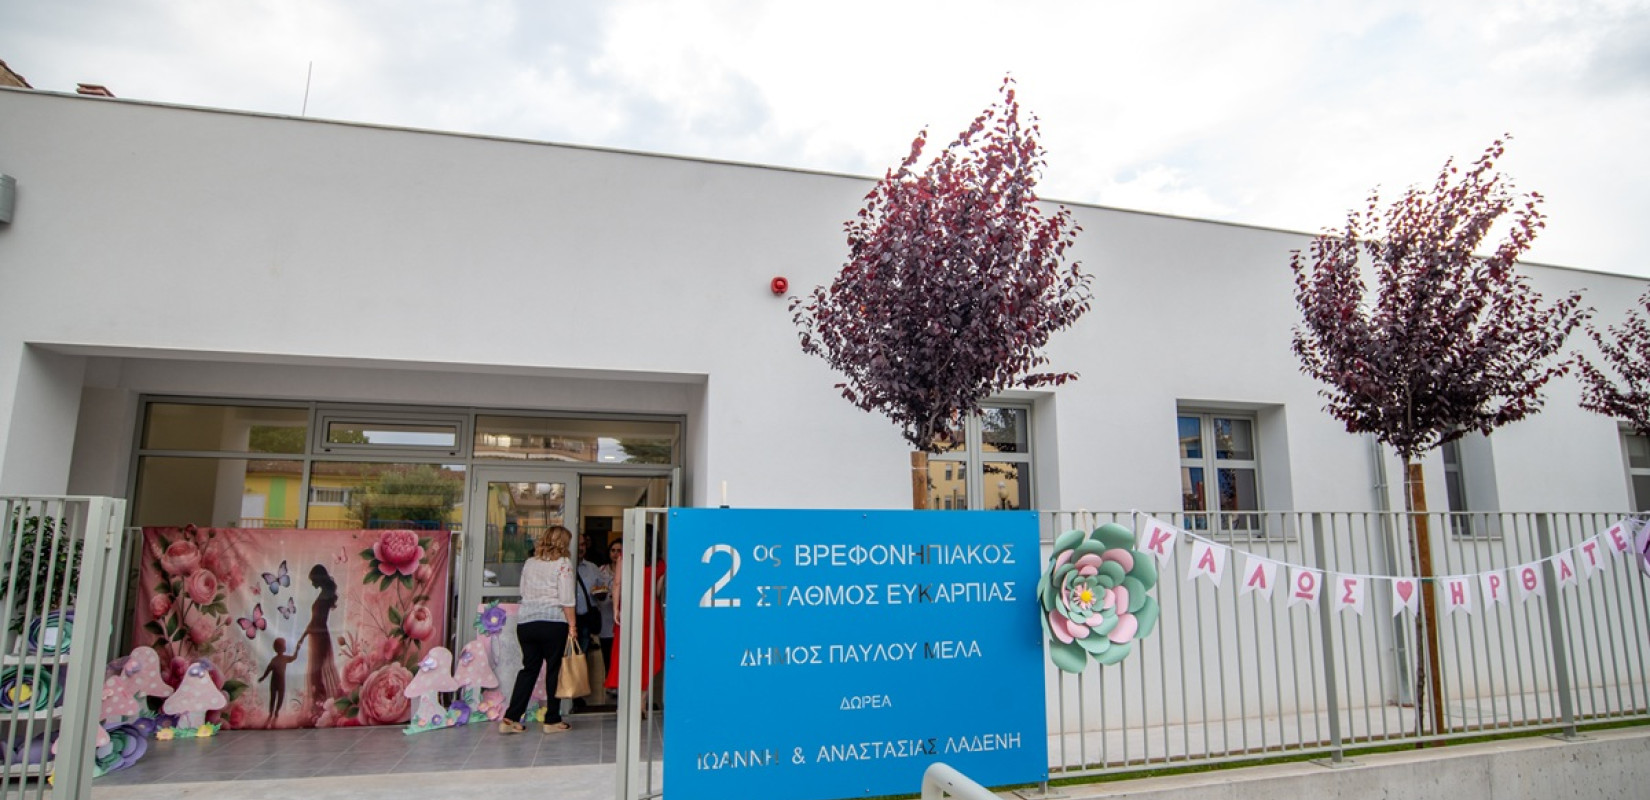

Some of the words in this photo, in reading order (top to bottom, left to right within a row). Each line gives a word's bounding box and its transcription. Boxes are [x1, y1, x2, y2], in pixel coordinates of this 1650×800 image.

[794, 543, 1016, 567] ΒΡΕΦΟΝΗΠΙΑΚΟΣ
[1147, 526, 1358, 604] ΚΑΛΩΣ
[1449, 525, 1627, 605] ΗΡΘΑΤΕ
[755, 584, 879, 607] ΣΤΑΘΜΟΣ
[886, 581, 1017, 605] ΕΥΚΑΡΠΙΑΣ
[740, 645, 823, 667] ΔΗΜΟΣ
[828, 642, 918, 664] ΠΑΥΛΟΥ
[923, 640, 982, 660] ΜΕΛΑ
[839, 695, 892, 710] ΔΩΡΕΑ
[697, 748, 780, 770] ΙΩΑΝΝΗ
[791, 747, 806, 764] &
[816, 738, 938, 763] ΑΝΑΣΤΑΣΙΑΣ
[944, 732, 1021, 754] ΛΑΔΕΝΗ
